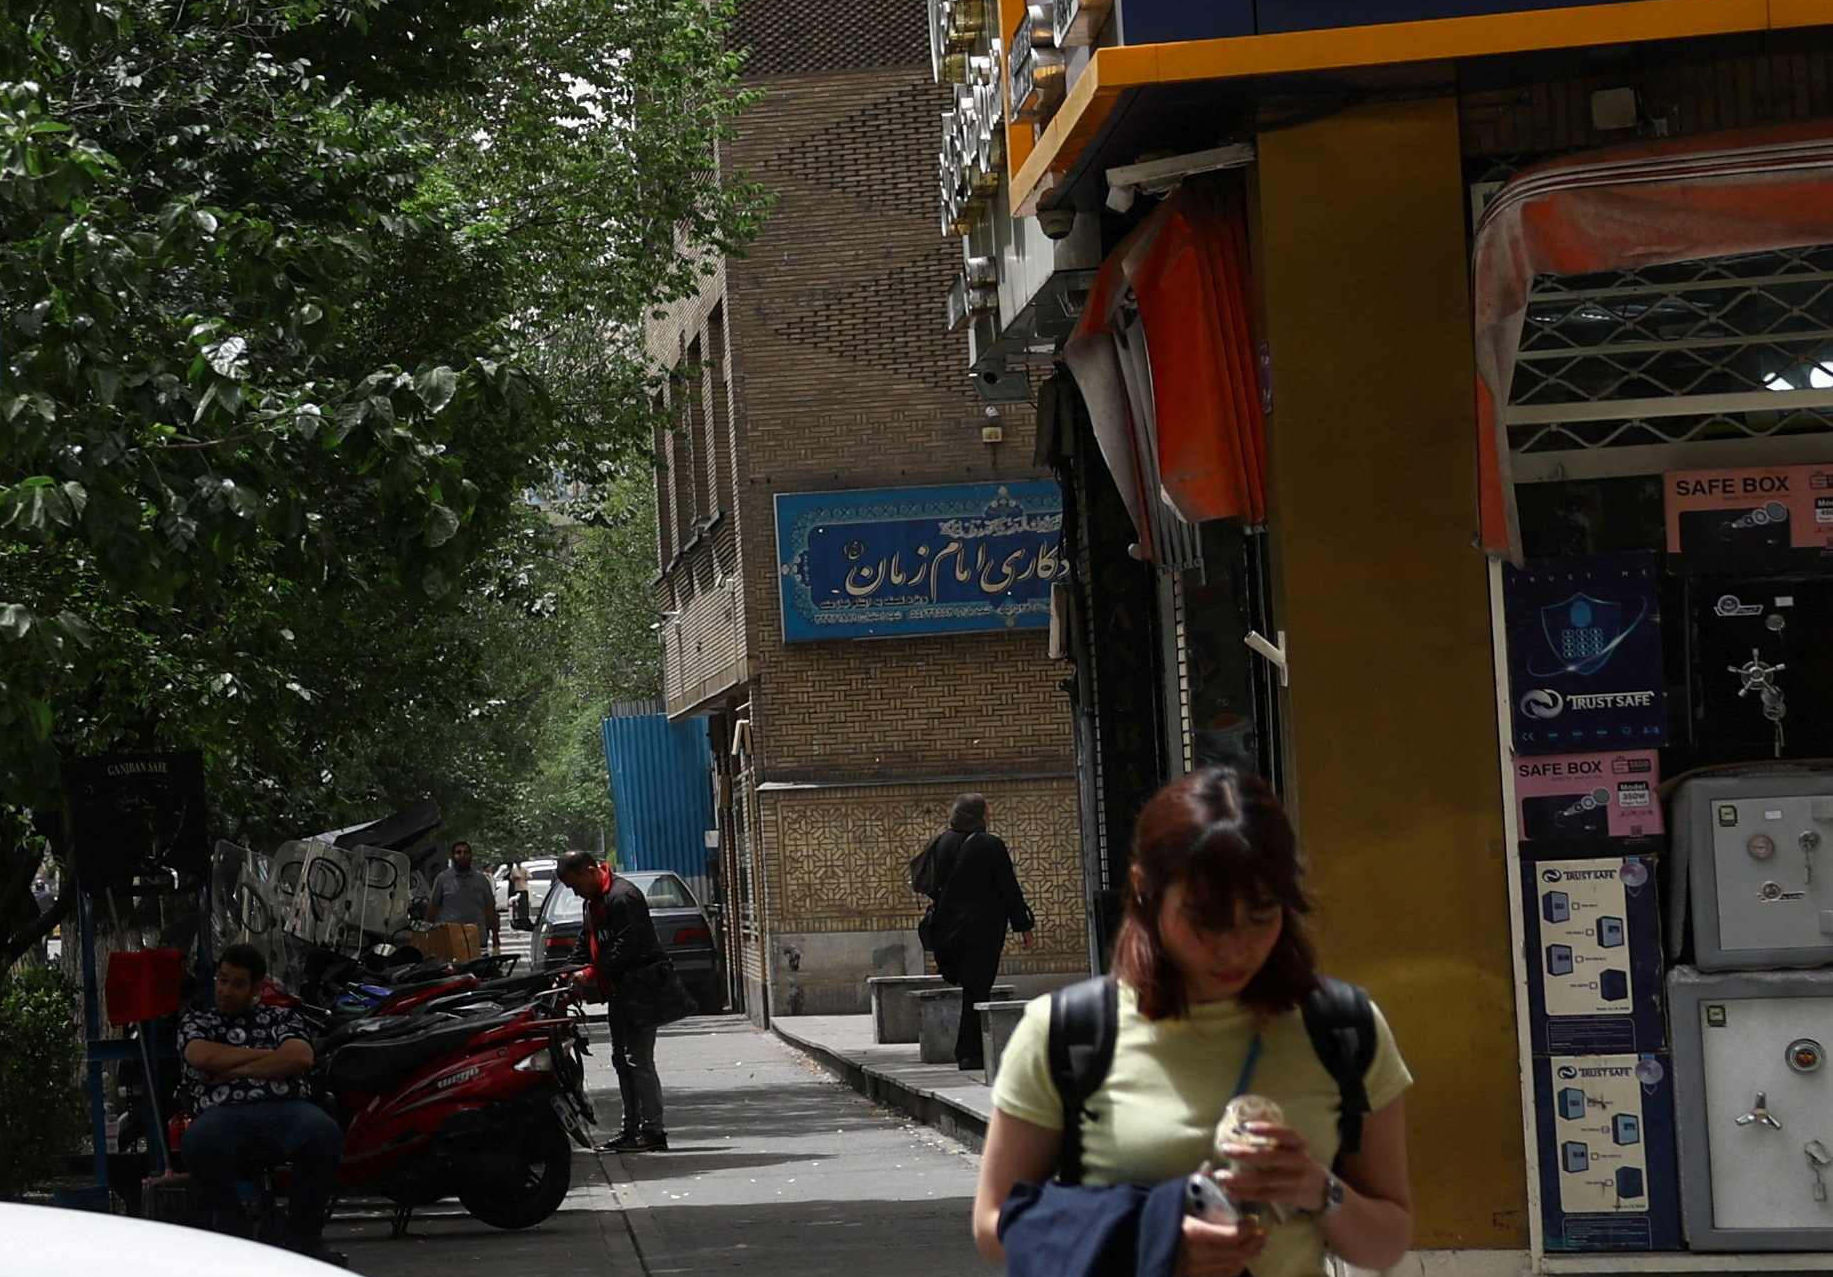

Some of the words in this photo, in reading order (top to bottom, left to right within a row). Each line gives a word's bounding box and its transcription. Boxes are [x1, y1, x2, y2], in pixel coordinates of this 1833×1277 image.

[1676, 479, 1735, 496] SAFE
[1743, 475, 1790, 493] BOX
[845, 544, 929, 597] زمان
[931, 540, 985, 603] امام
[1567, 694, 1614, 710] TRUST
[1616, 691, 1654, 707] SAFE
[1519, 762, 1562, 777] SAFE
[1568, 761, 1602, 774] BOX
[1563, 870, 1592, 881] TRUST
[1593, 869, 1617, 880] SAFE
[1578, 1067, 1607, 1078] TRUST
[1608, 1067, 1633, 1078] SAFE
